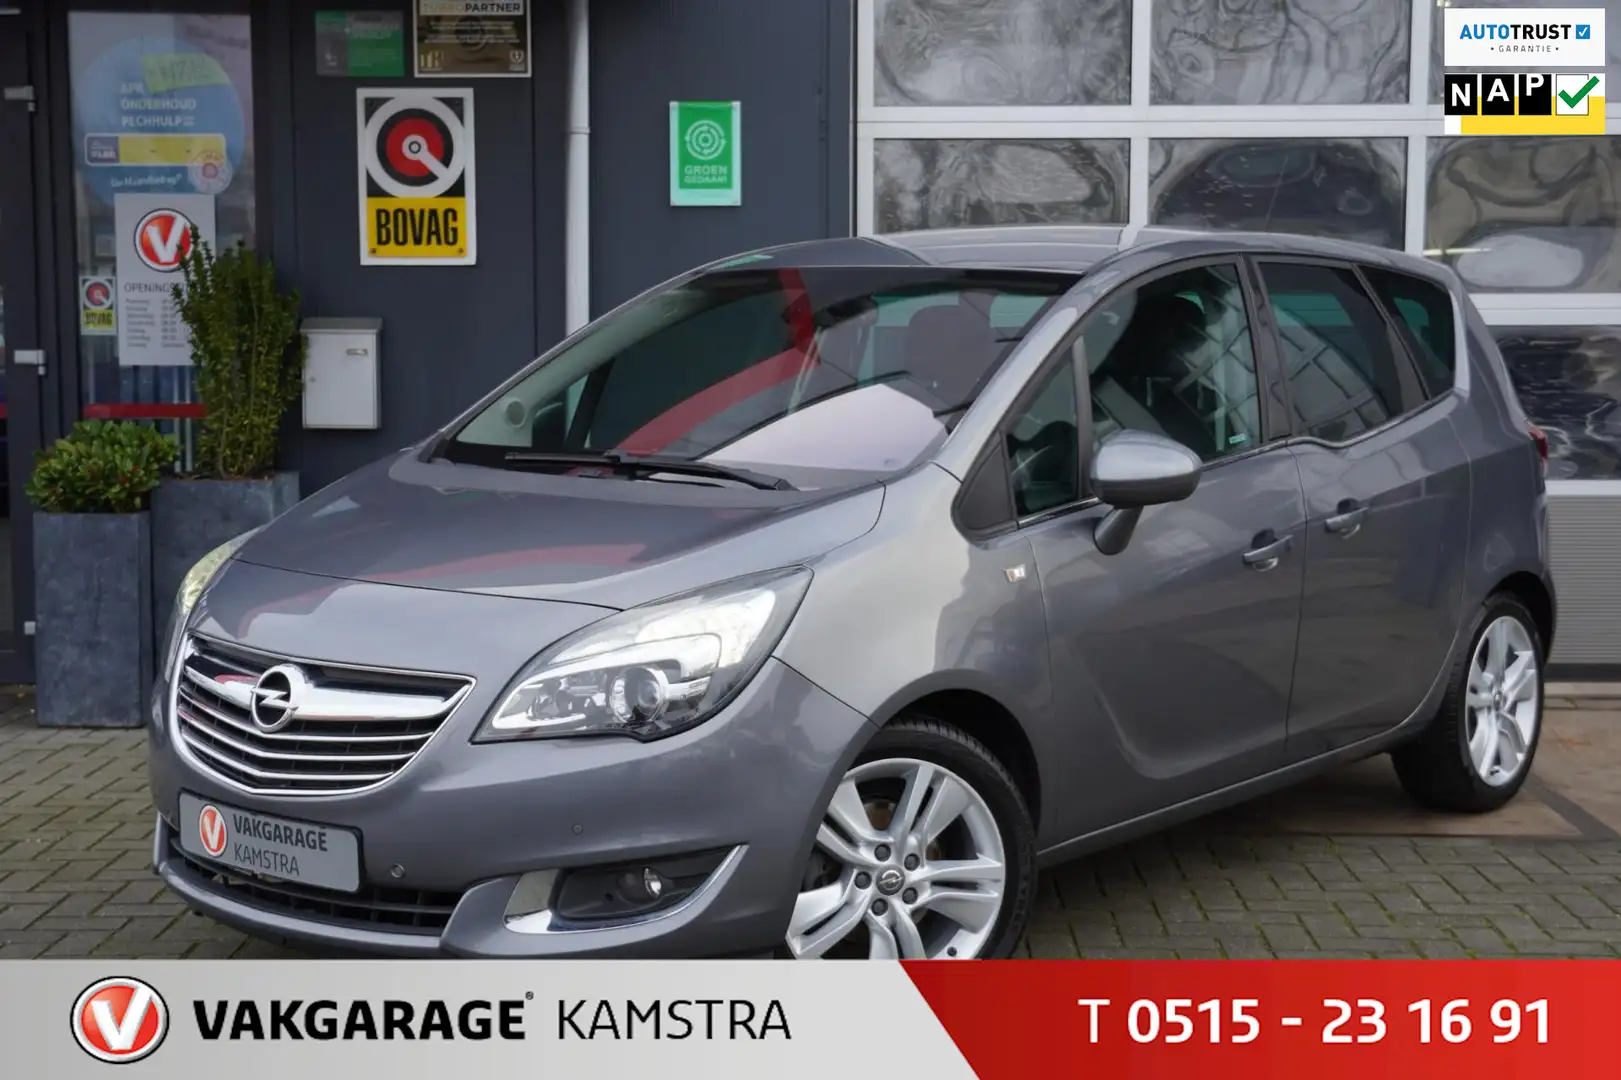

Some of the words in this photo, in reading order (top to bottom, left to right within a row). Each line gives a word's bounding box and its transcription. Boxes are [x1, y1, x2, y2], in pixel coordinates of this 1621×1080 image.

[120, 99, 196, 110] ONDERHOUD
[121, 116, 182, 126] PECHHULP
[684, 165, 728, 175] GROEN
[375, 208, 458, 246] BOVAG
[233, 814, 328, 851] VAKGARAGE
[233, 842, 300, 876] KAMSTRA
